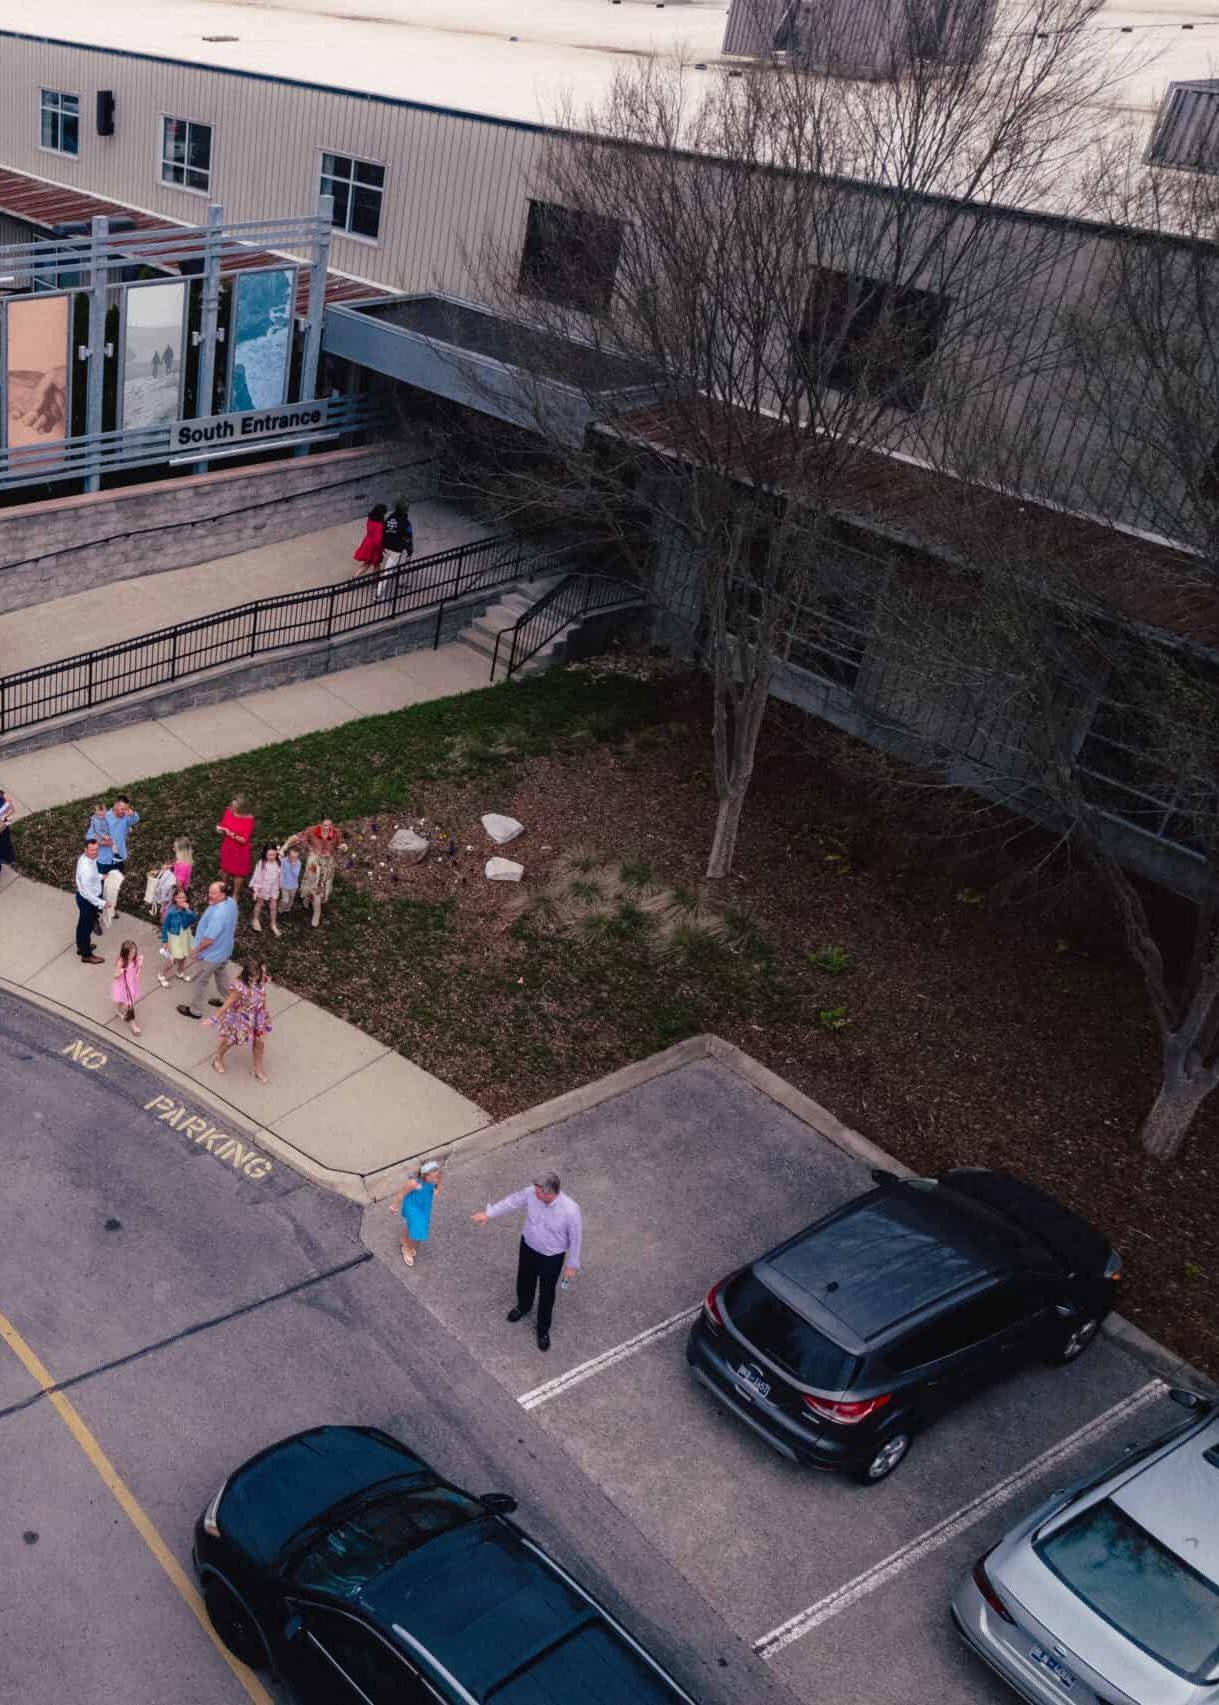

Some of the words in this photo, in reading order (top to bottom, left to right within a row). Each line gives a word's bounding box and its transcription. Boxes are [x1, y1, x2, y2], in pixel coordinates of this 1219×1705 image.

[178, 421, 234, 445] South
[241, 409, 321, 435] Entrance
[62, 1039, 109, 1070] NO
[144, 1094, 273, 1179] PARKING
